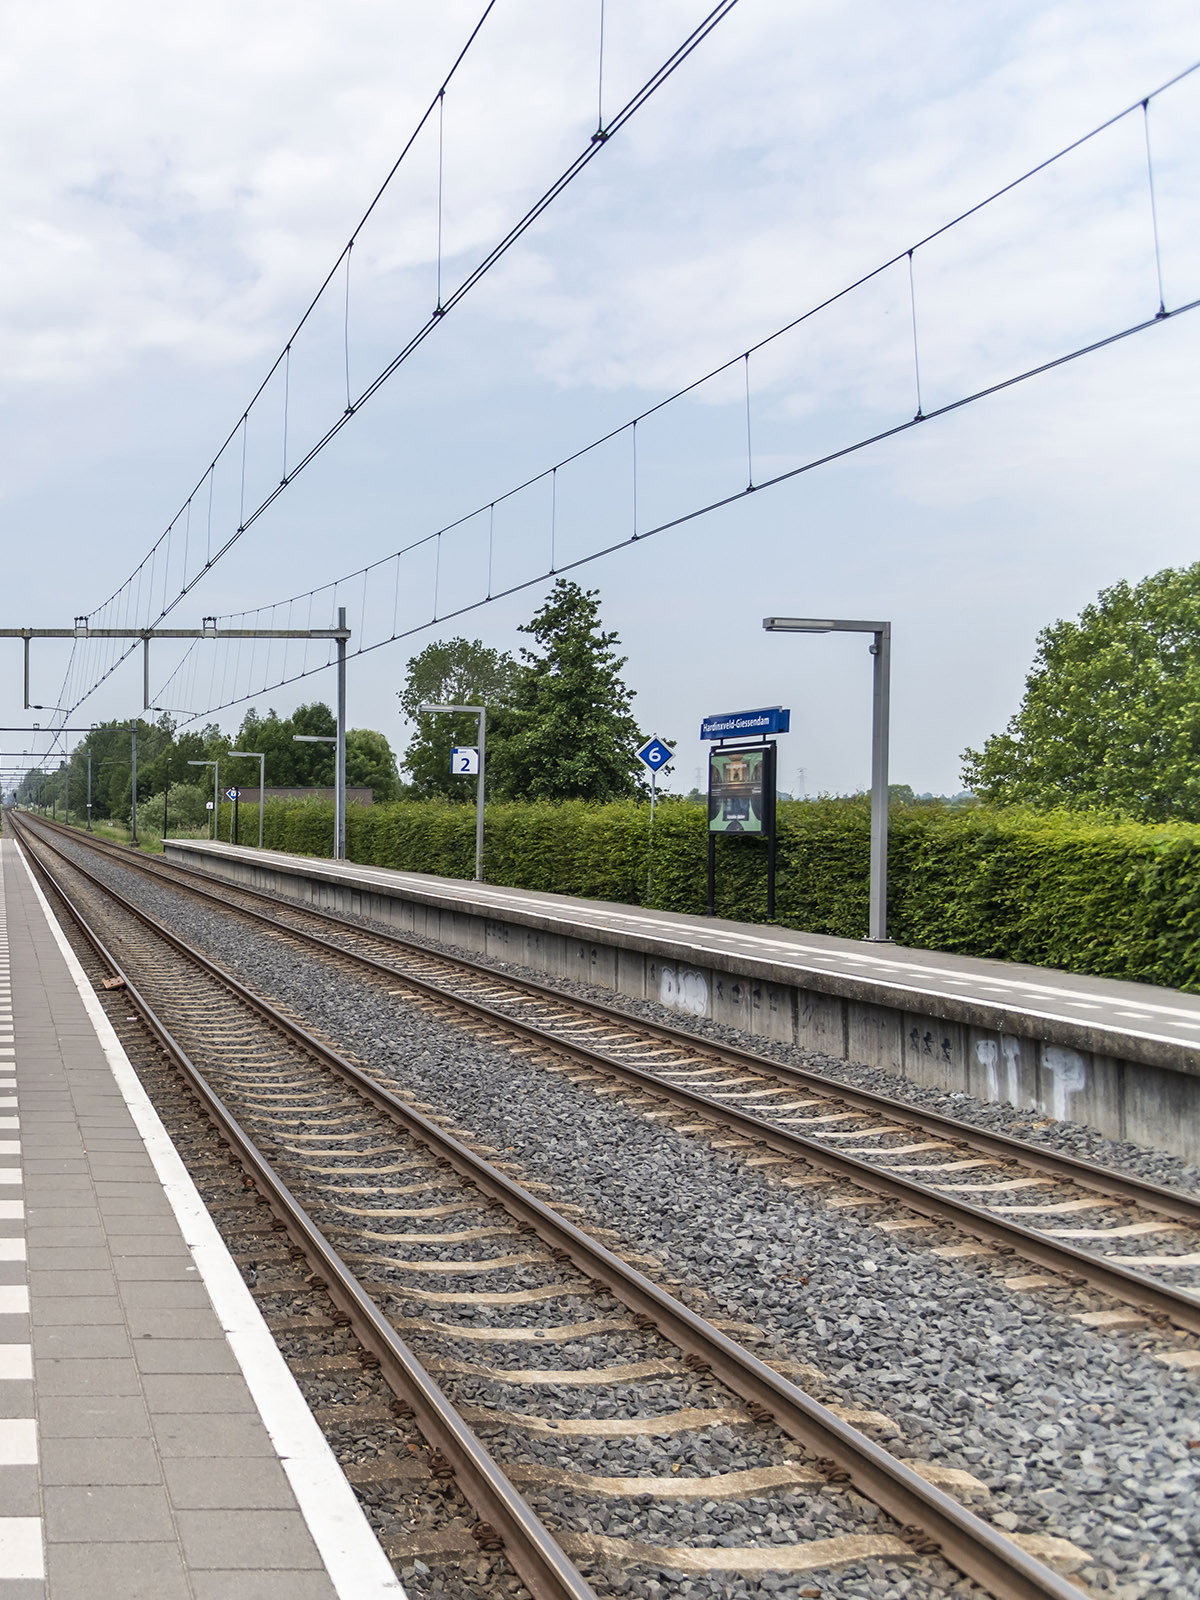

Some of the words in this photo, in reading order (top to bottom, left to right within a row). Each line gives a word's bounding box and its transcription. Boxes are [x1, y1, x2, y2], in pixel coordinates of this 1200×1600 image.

[703, 716, 769, 732] Hardinxveld-Giessendam
[648, 747, 661, 762] 6
[461, 758, 470, 771] 2
